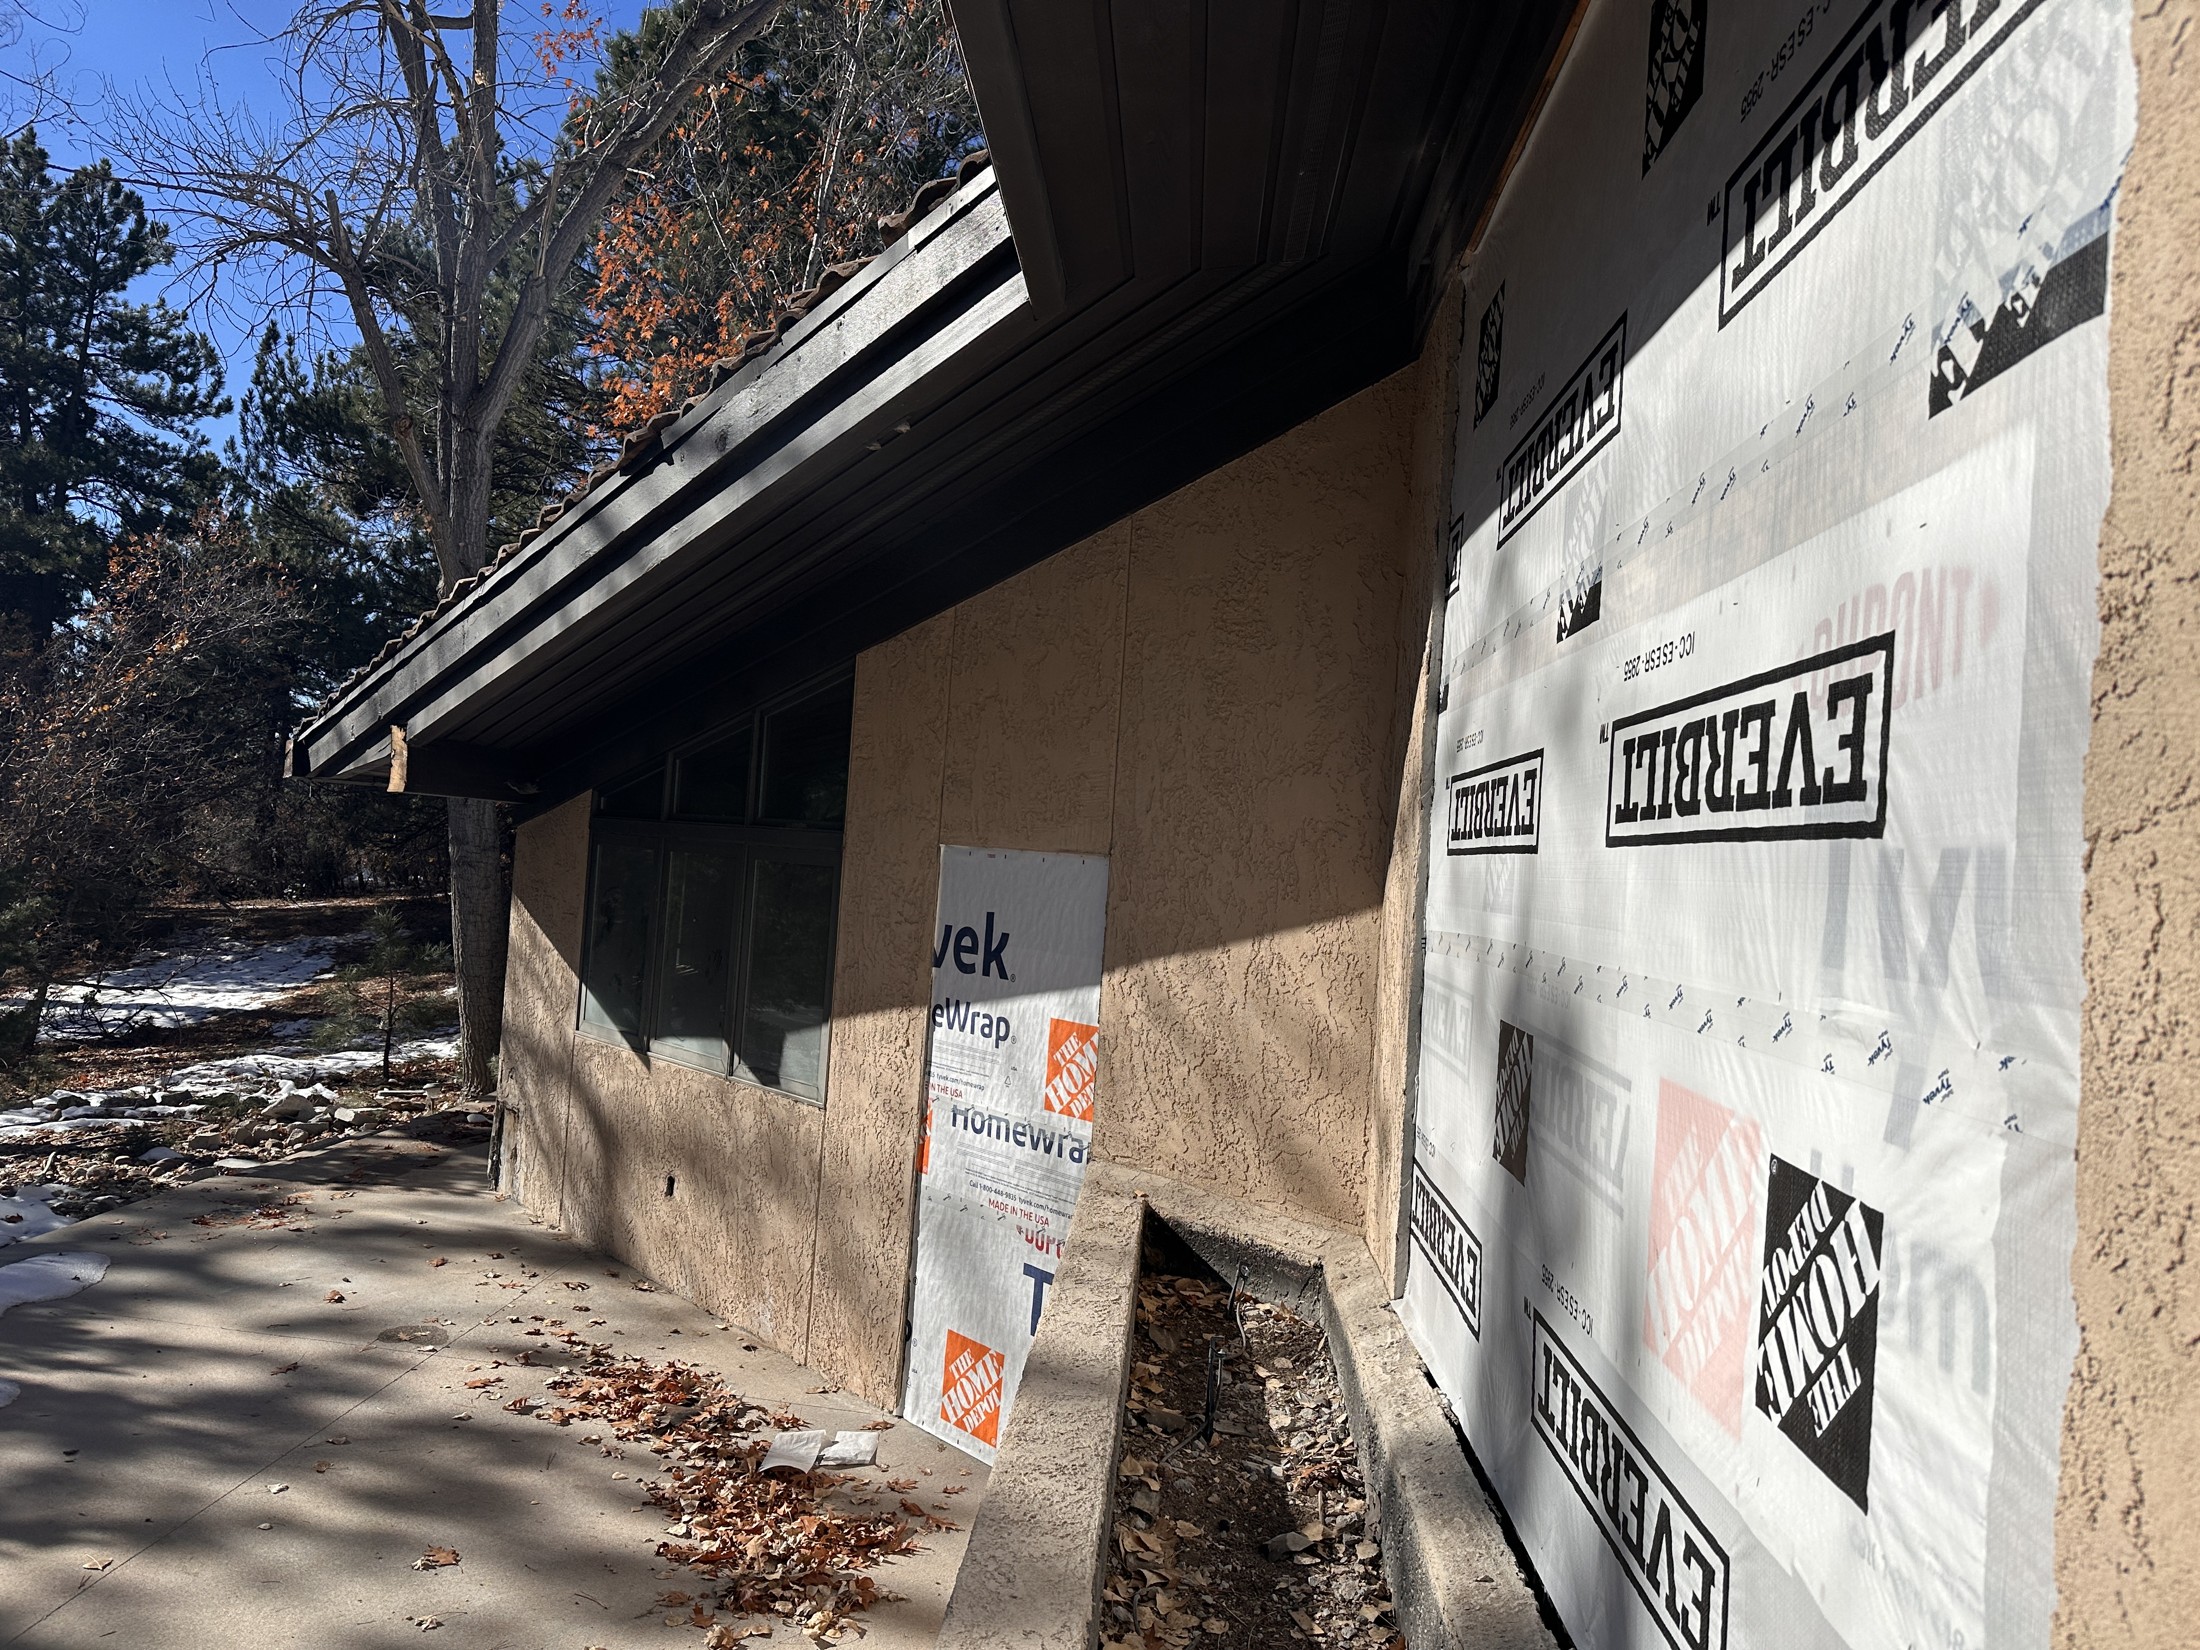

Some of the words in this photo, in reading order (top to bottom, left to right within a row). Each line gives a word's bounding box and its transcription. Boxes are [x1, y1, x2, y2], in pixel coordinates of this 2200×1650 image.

[1502, 340, 1618, 530] EVERBILT
[1615, 672, 1873, 824] EVERBILT
[1451, 768, 1537, 841] EVERBILT
[937, 1084, 949, 1095] THE
[950, 1087, 963, 1099] USA
[1053, 1032, 1082, 1068] THE
[989, 1198, 1009, 1213] MADE
[1010, 1206, 1018, 1218] IN
[1020, 1208, 1033, 1222] THE
[1035, 1213, 1050, 1227] USA
[1411, 1174, 1478, 1318] EVERBILT
[1763, 1180, 1834, 1318] DEPOT
[1757, 1199, 1880, 1427] HOME
[942, 1349, 1003, 1425] HOME
[949, 1348, 975, 1380] THE
[1806, 1343, 1861, 1438] THE
[962, 1387, 1001, 1434] DEPOT
[1537, 1340, 1717, 1650] EVERBILT
